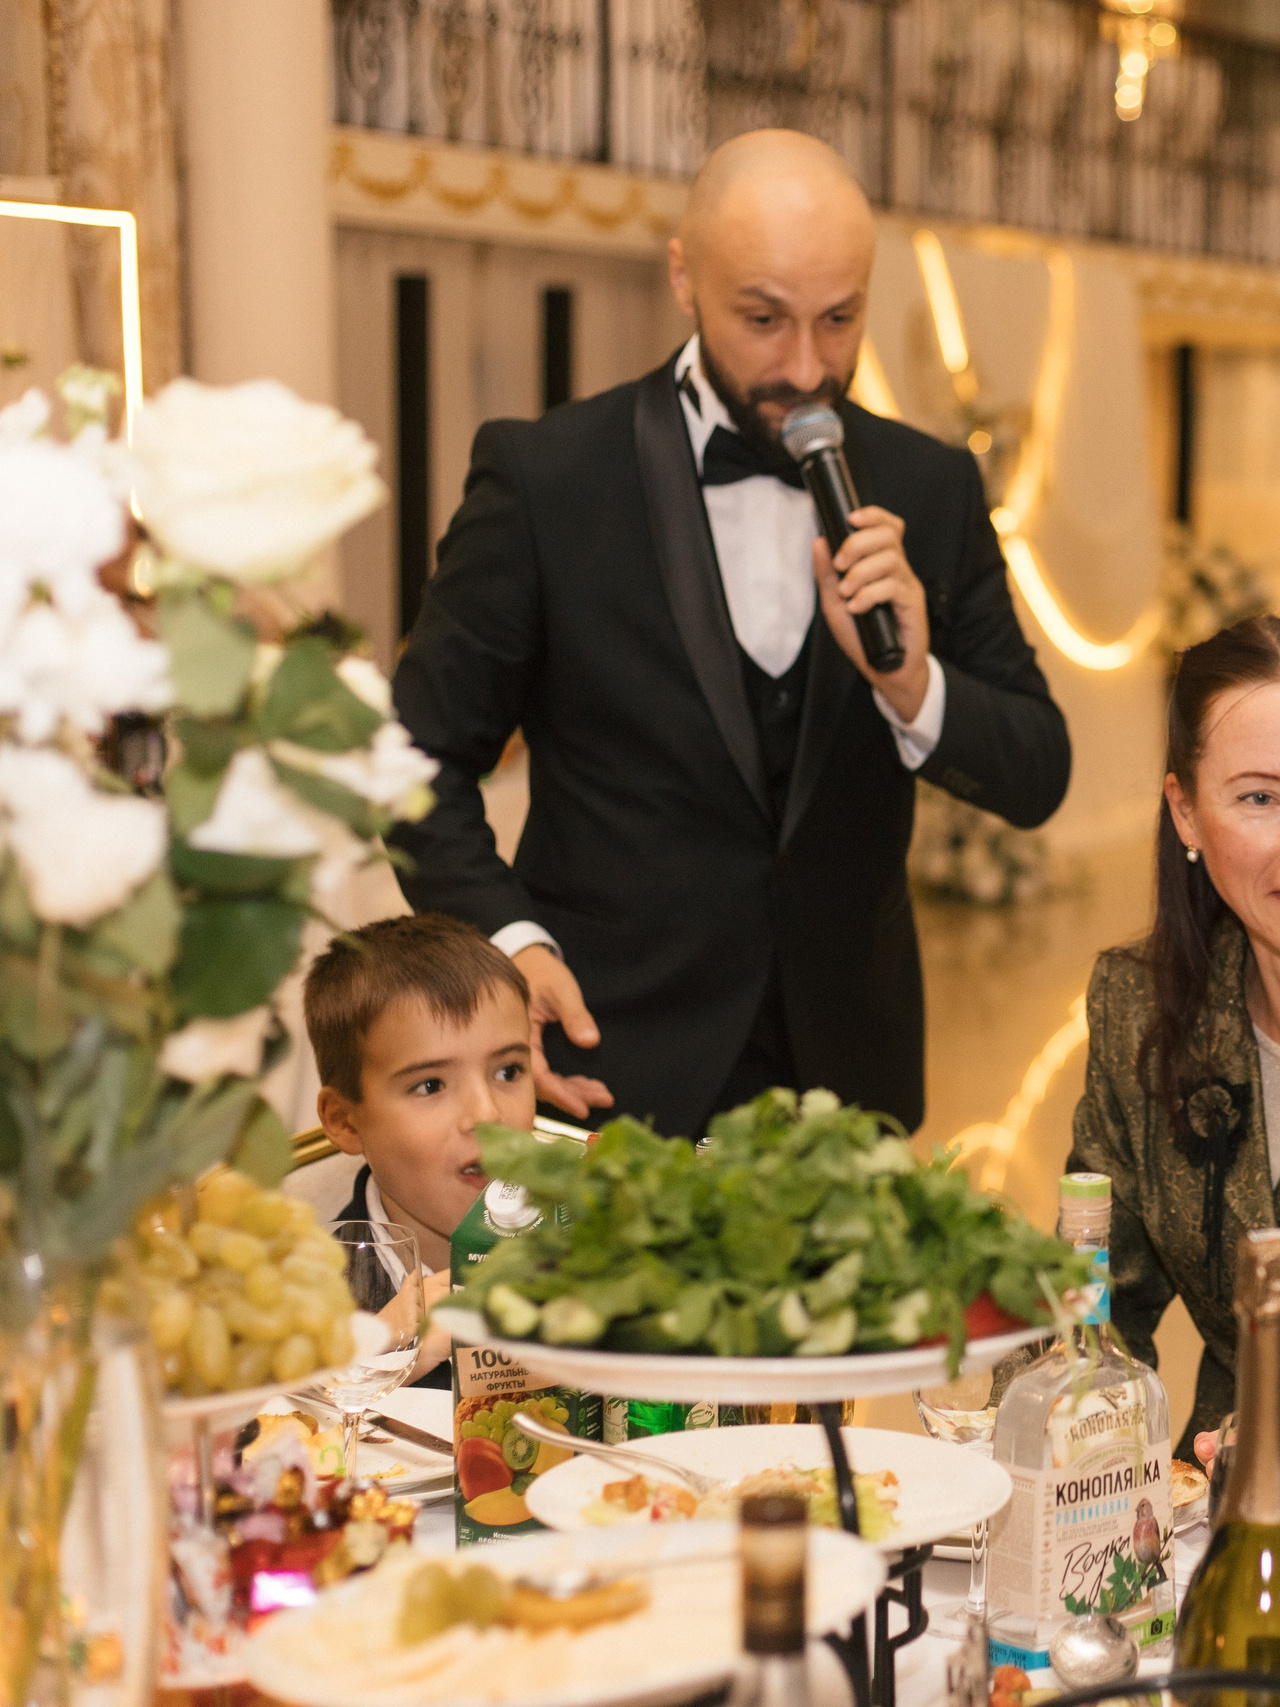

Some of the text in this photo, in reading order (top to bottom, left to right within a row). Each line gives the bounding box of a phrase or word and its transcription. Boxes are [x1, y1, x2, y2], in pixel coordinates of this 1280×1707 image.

[471, 1348, 520, 1369] 100
[470, 1368, 532, 1381] НАТУРАЛЬНЫ
[486, 1380, 526, 1391] ФРУКТЫ
